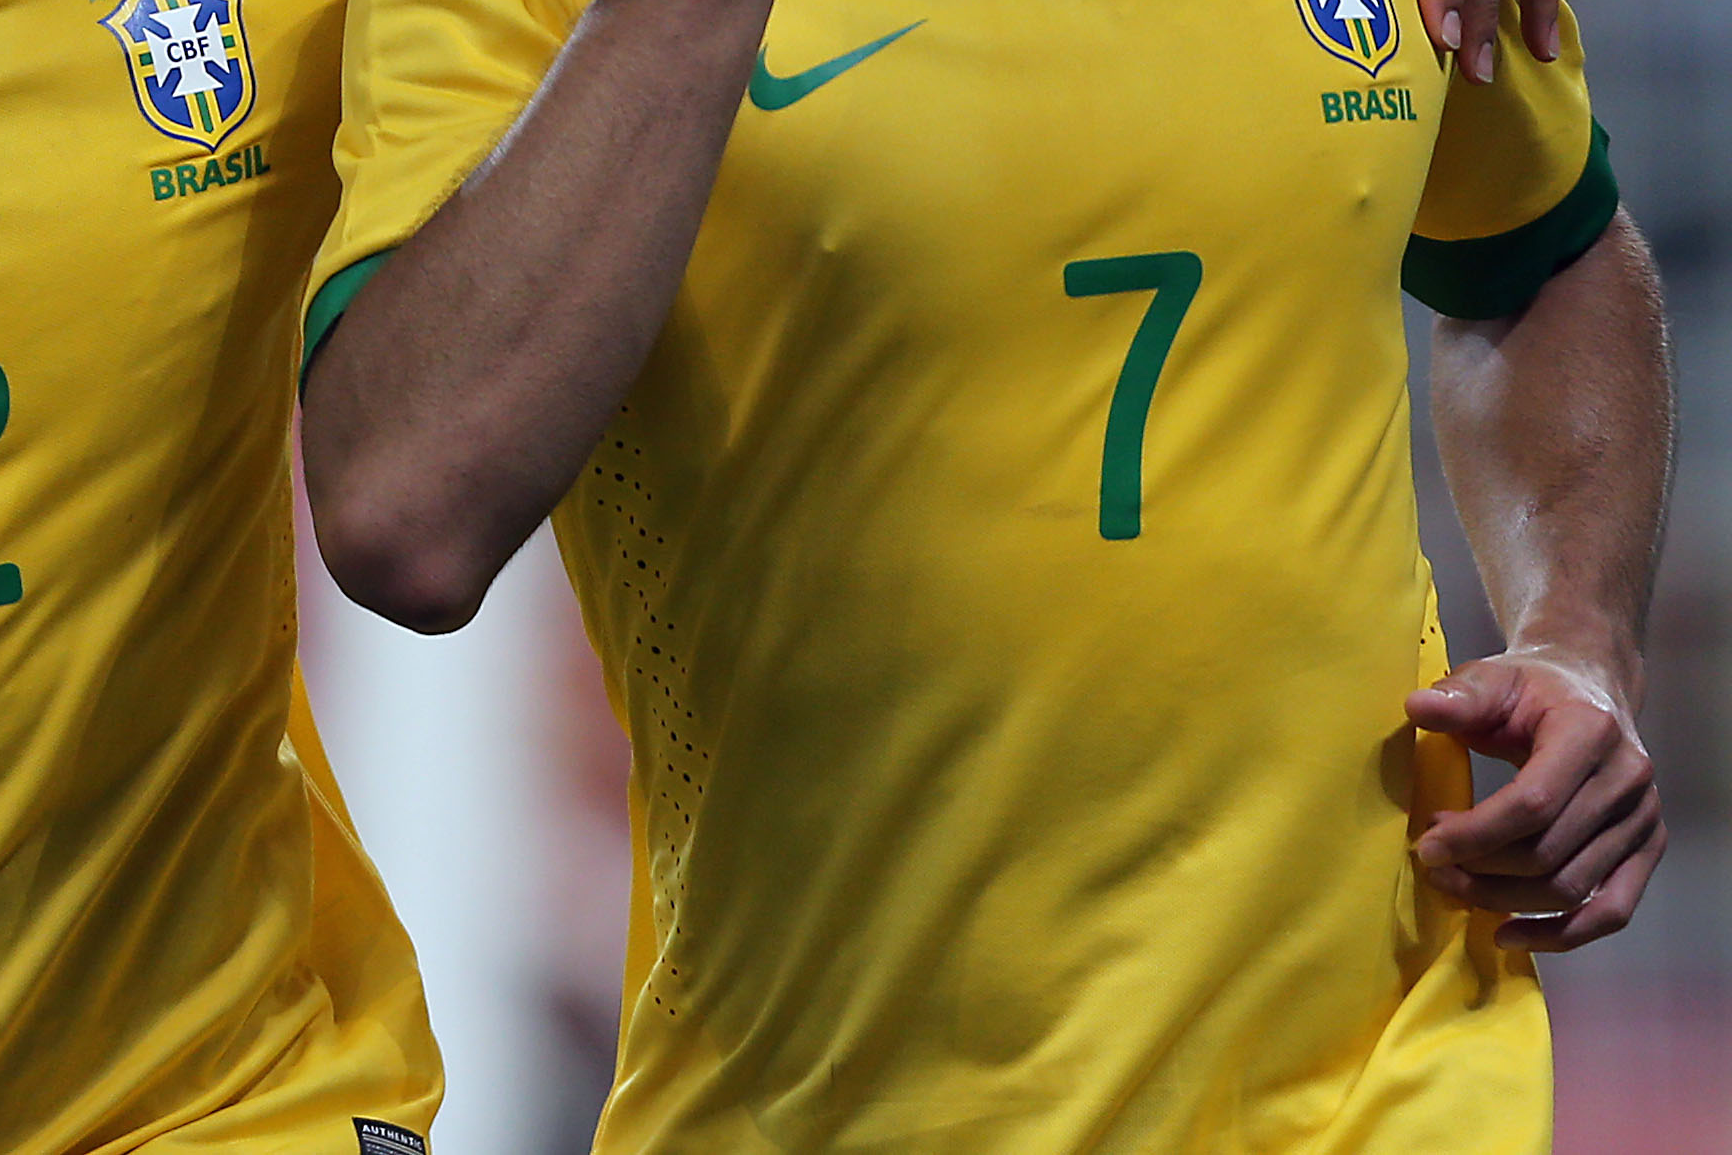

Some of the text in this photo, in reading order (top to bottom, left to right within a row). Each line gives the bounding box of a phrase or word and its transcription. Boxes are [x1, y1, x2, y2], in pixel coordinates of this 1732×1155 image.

[166, 36, 210, 63] CBF
[1321, 88, 1417, 124] BRASIL
[150, 145, 271, 201] BRASIL
[1063, 250, 1203, 540] 7
